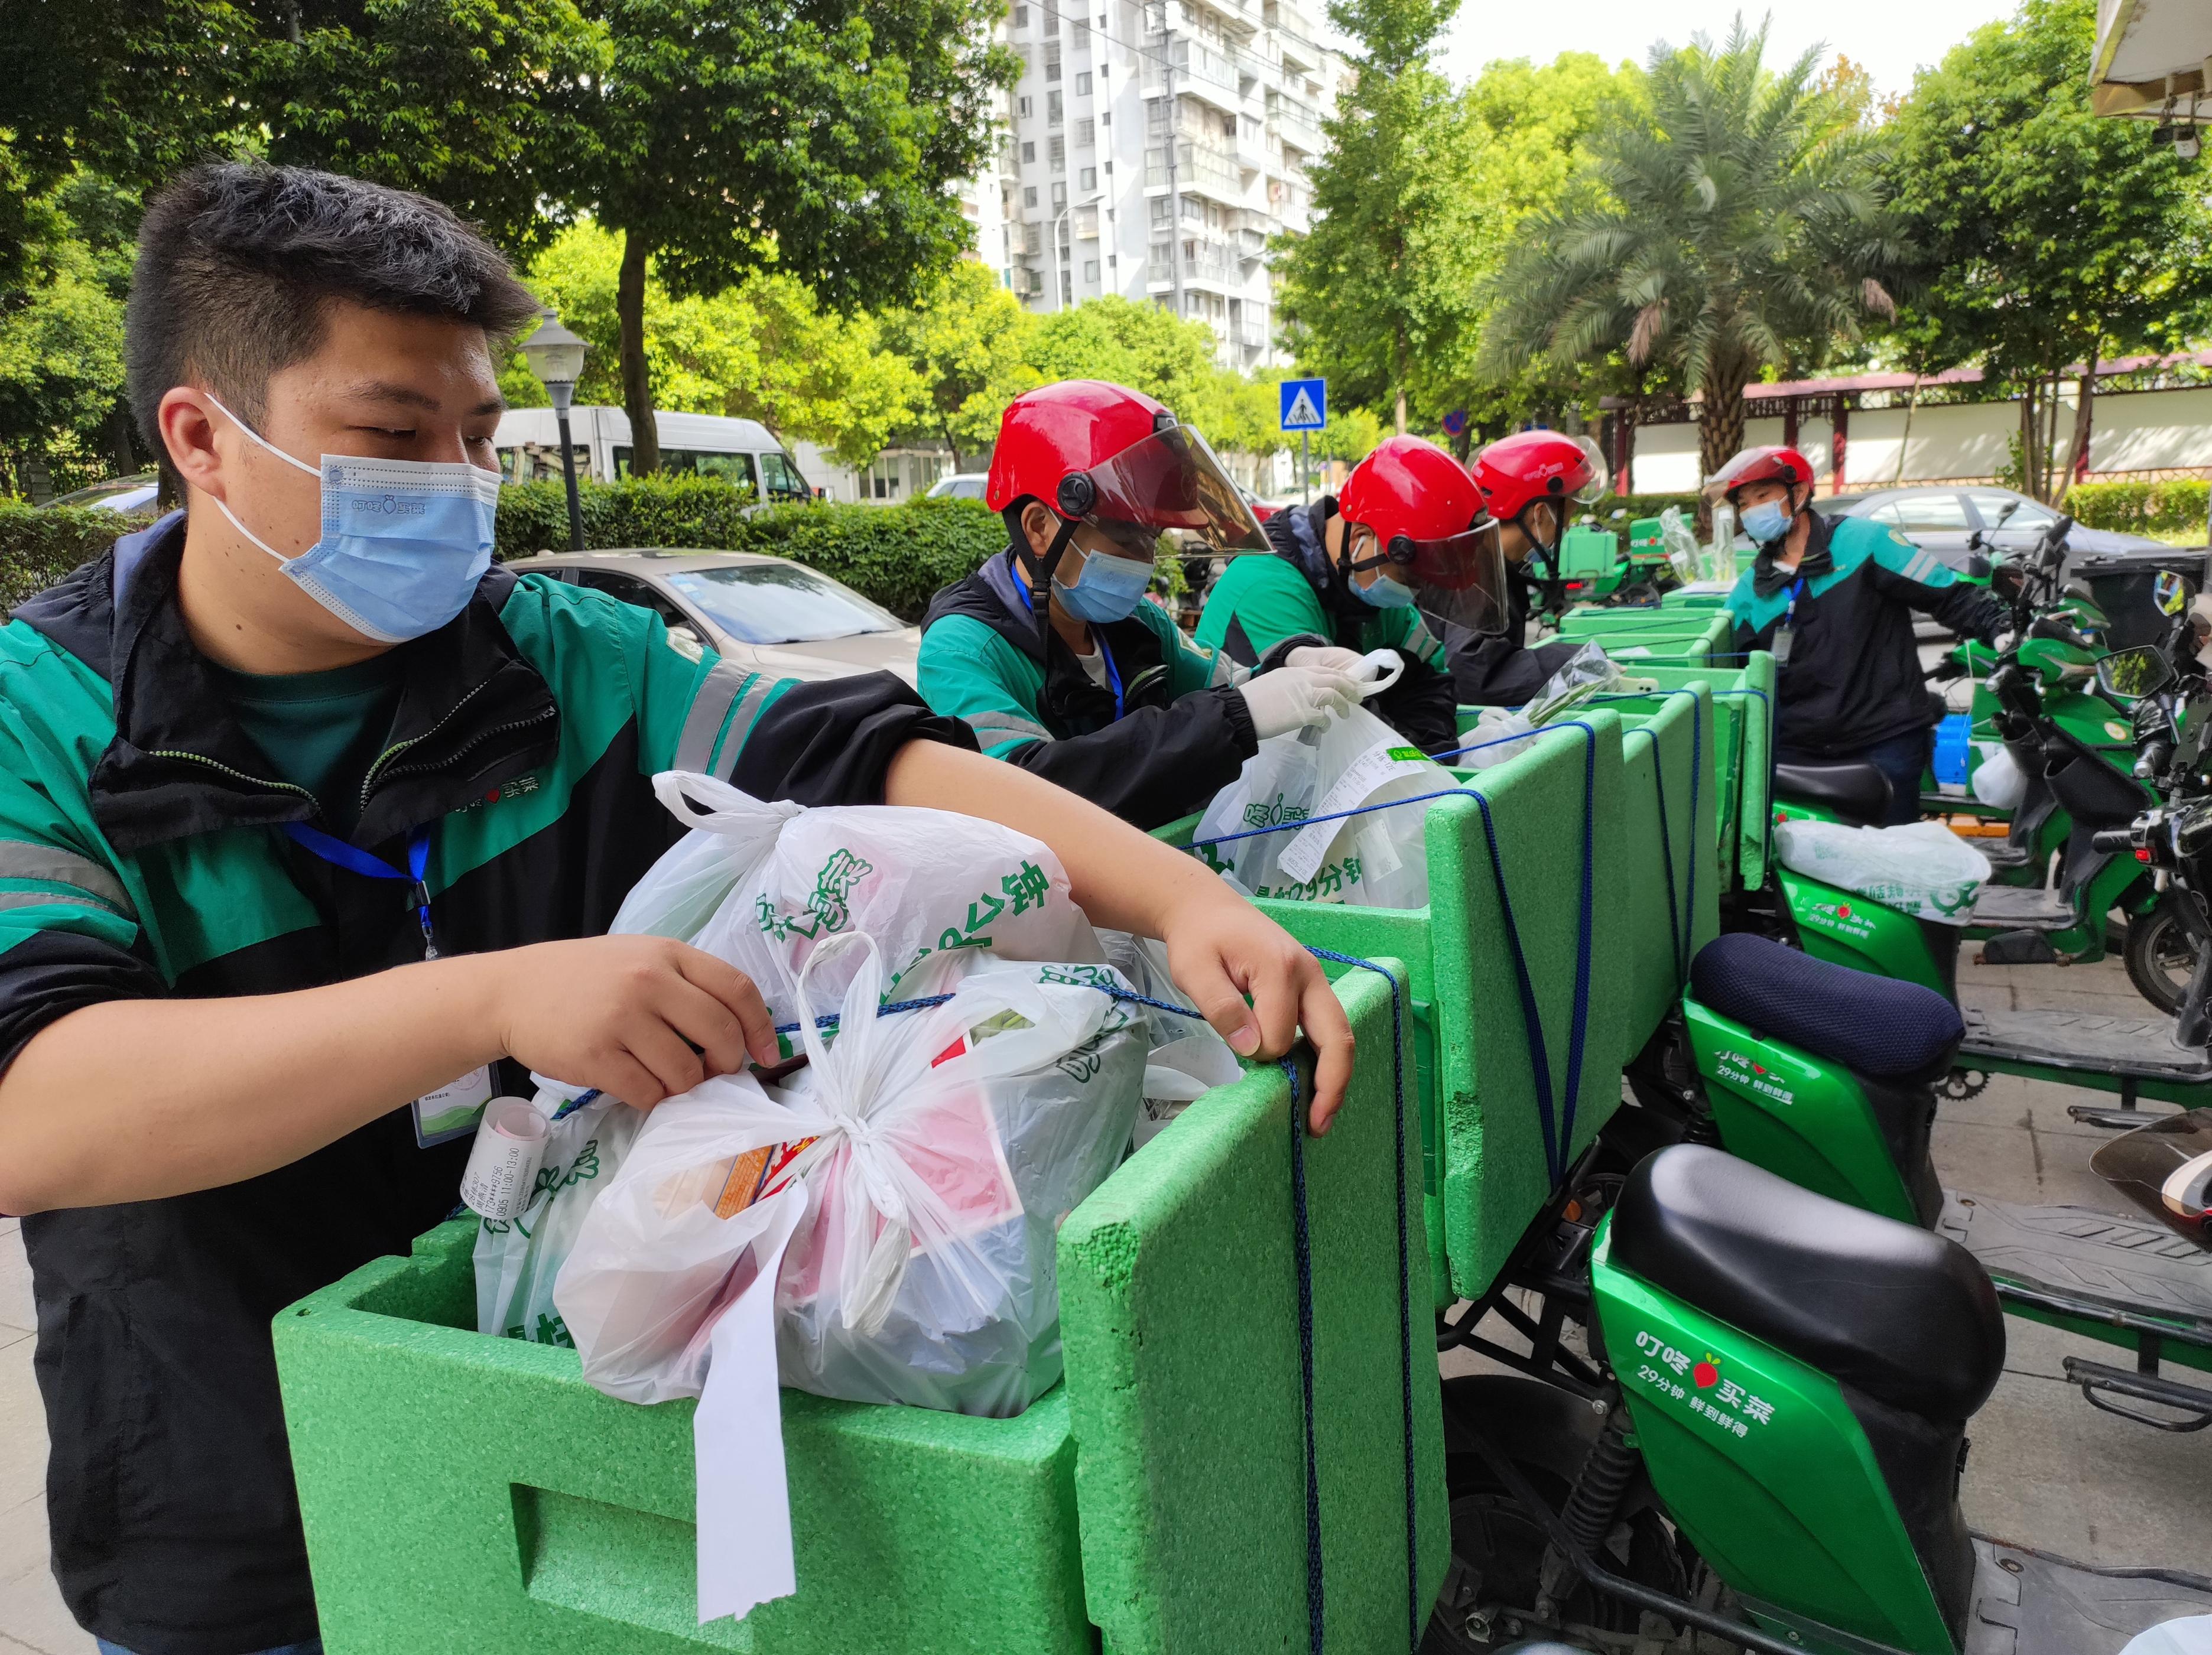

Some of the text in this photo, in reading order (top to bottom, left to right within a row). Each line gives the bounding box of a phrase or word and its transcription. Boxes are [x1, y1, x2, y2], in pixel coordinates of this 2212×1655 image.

[1635, 1331, 1776, 1425] 叮咚 买菜
[1636, 1364, 1749, 1439] 29分钟 鲜到鲜得
